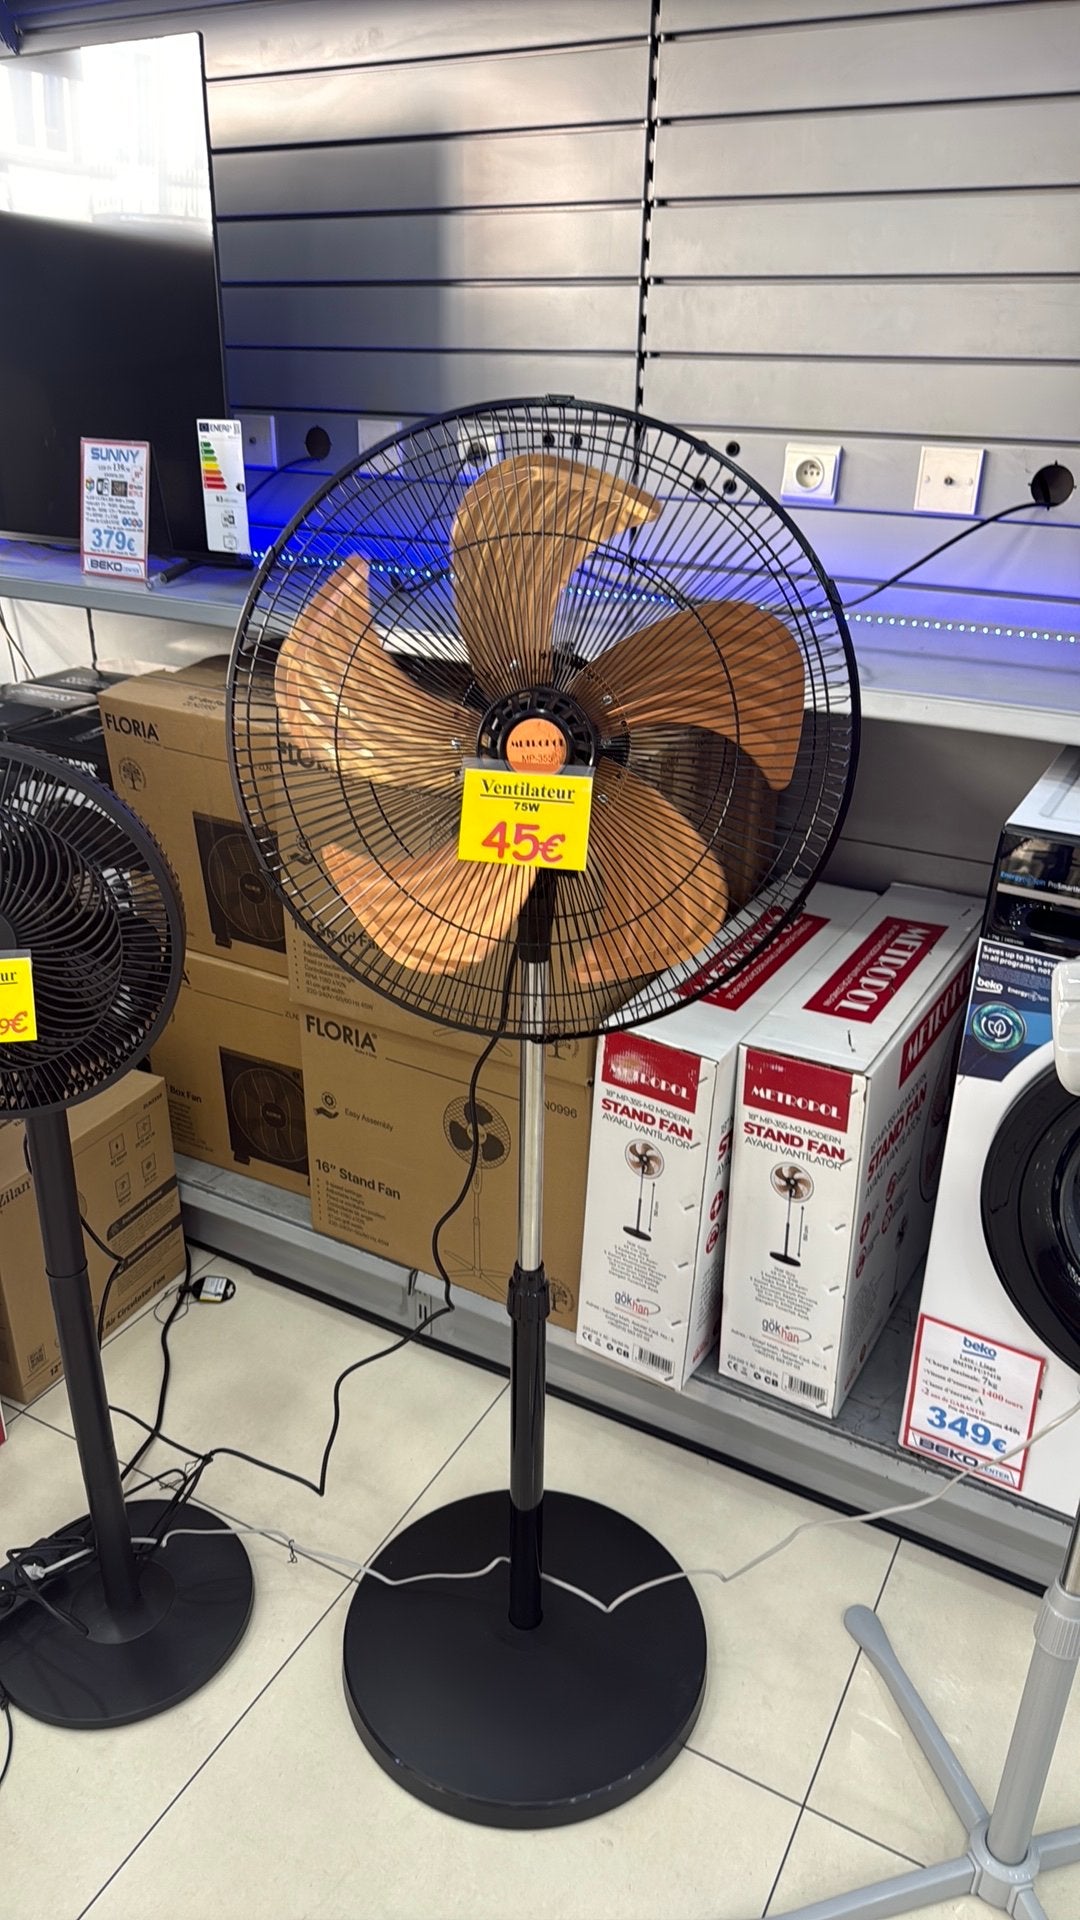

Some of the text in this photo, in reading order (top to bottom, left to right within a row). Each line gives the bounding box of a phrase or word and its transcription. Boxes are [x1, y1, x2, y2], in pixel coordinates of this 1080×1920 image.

[90, 447, 139, 463] SUNNY
[92, 528, 136, 552] 379€
[90, 559, 122, 572] BEKO
[104, 712, 159, 741] FLORIA
[482, 778, 575, 800] Ventilateur
[514, 801, 540, 812] 75W
[481, 821, 566, 863] 45€
[983, 945, 1004, 956] Saves
[1005, 951, 1015, 960] up
[1016, 952, 1024, 960] to
[977, 976, 1003, 991] beko
[905, 956, 973, 1070] METROPO
[305, 1014, 376, 1053] FLORIA
[752, 1086, 841, 1120] METROPOL
[344, 1107, 393, 1132] Easy Assembly
[602, 1098, 693, 1141] STAND FAN
[602, 1113, 634, 1131] AYAKLI
[655, 1107, 690, 1125] MODERN
[743, 1122, 845, 1161] STAND FAN
[744, 1137, 779, 1152] AYAKLI
[803, 1129, 842, 1146] MODERN
[338, 1168, 376, 1191] Stand
[377, 1181, 401, 1201] Fan
[117, 1285, 153, 1319] Circulator
[152, 1273, 166, 1290] Fan
[614, 1292, 649, 1317] gökhan
[762, 1318, 799, 1345] gökhan
[963, 1336, 997, 1357] beko
[982, 1388, 1004, 1402] 1400
[927, 1406, 1007, 1455] 349€
[918, 1437, 979, 1469] BEKO
